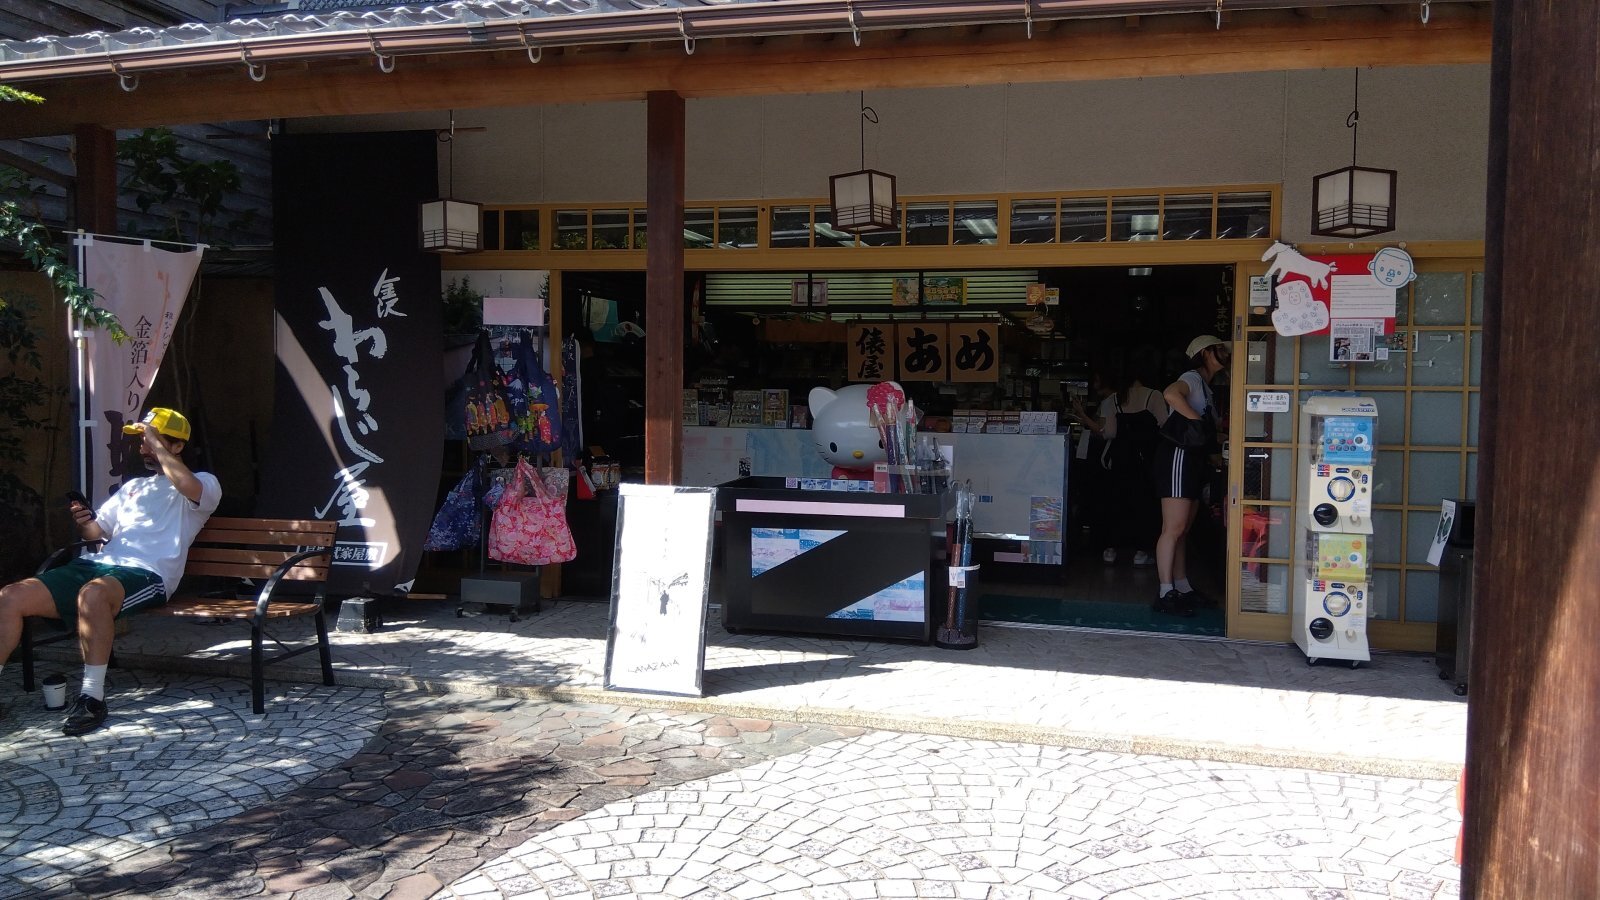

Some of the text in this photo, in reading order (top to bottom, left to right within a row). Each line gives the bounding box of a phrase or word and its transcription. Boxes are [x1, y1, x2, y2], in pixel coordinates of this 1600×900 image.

[127, 314, 153, 414] 金箔入り
[855, 327, 887, 379] 俵屋
[904, 328, 995, 374] あめ
[313, 286, 388, 528] わらじ屋
